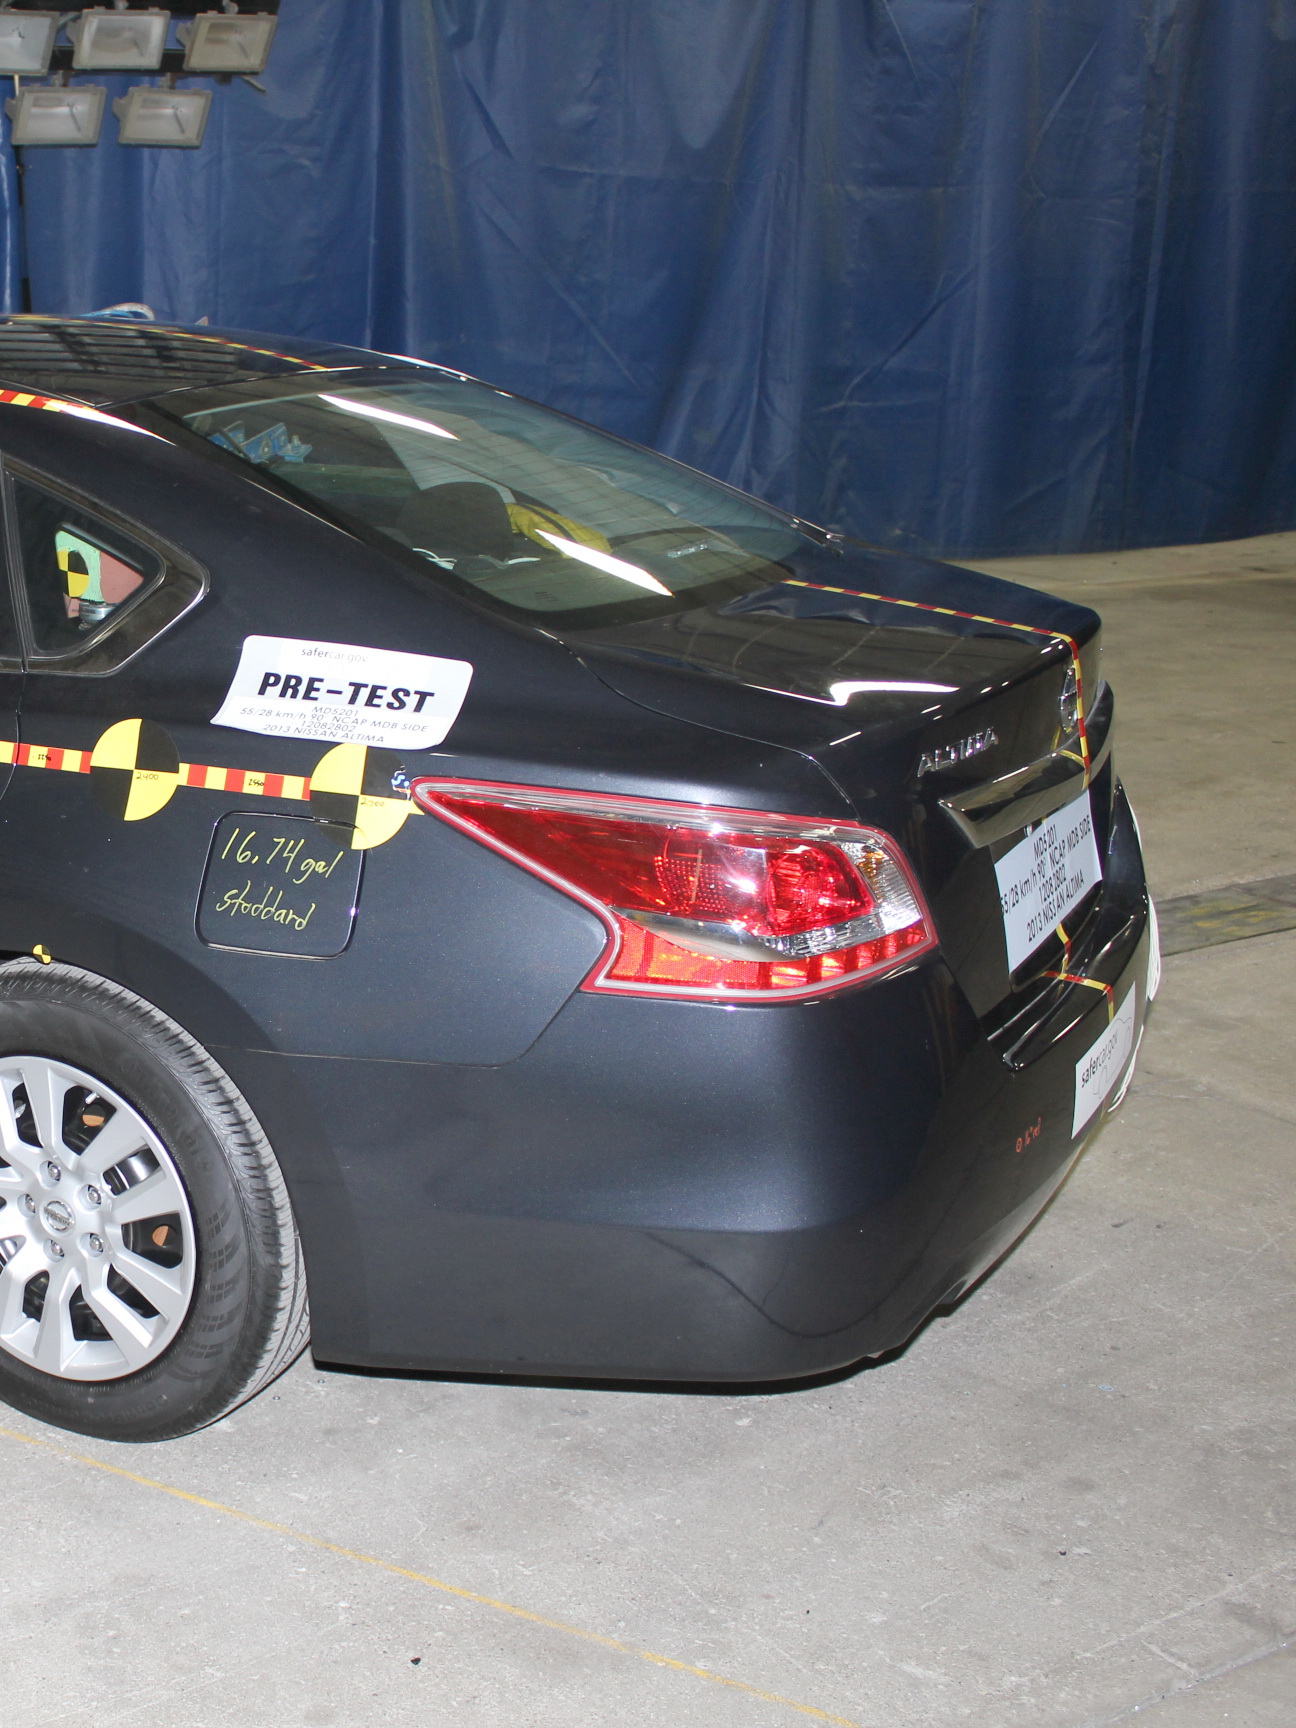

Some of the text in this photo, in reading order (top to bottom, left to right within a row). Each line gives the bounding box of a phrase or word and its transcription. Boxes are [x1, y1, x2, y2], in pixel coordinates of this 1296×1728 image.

[301, 647, 368, 663] safercargov
[257, 671, 435, 713] PRE-TEST
[240, 707, 273, 717] 55/28
[275, 710, 307, 720] km/h
[332, 716, 368, 726] NCAP
[370, 720, 398, 729] MDB
[401, 723, 429, 732] SIDE
[312, 706, 359, 717] MD5201
[262, 724, 385, 743] 2013 NISSAN ALTIMA
[301, 720, 356, 733] 12082802
[135, 771, 159, 781] 2400
[360, 797, 385, 807] 2700
[1048, 839, 1066, 870] NCAP
[1079, 813, 1091, 840] SIDE
[292, 850, 344, 884] gal
[1026, 912, 1043, 942] 2013
[1065, 868, 1085, 902] ALTIMA
